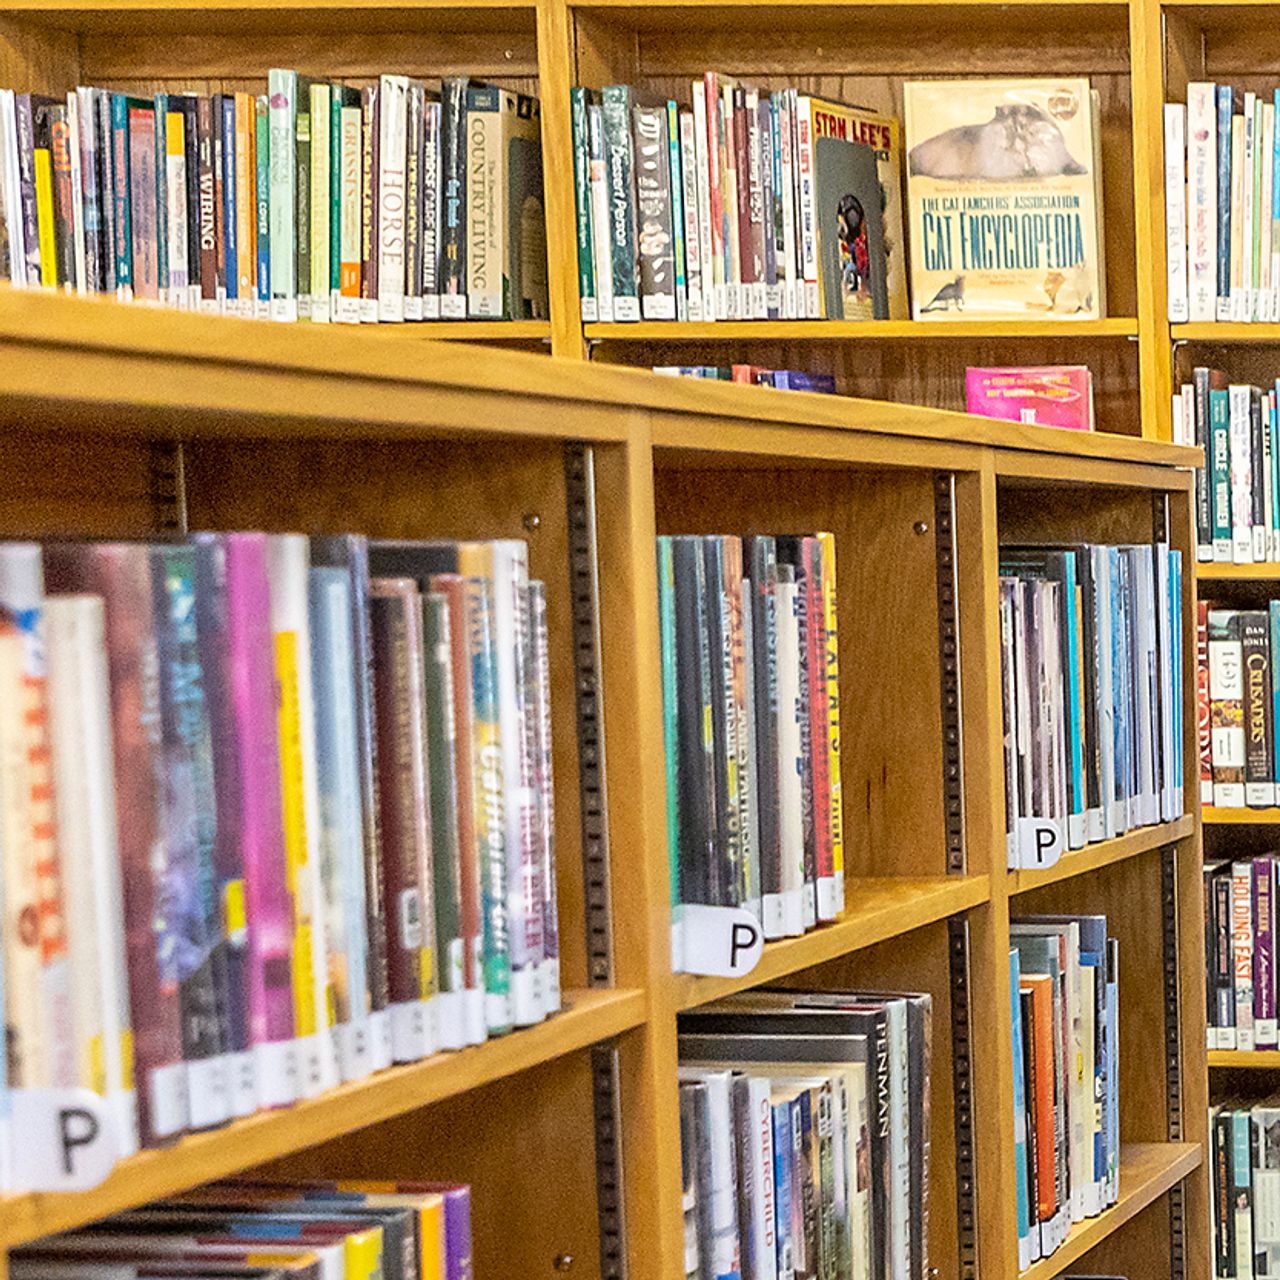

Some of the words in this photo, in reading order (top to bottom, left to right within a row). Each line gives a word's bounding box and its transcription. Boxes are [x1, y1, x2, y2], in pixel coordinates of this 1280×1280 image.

[815, 111, 847, 140] STAN
[852, 123, 891, 151] LEE'S
[471, 118, 486, 214] COUNTRY
[611, 144, 626, 198] Dessert
[200, 172, 215, 251] WIRING
[382, 168, 404, 267] HORSE
[613, 199, 628, 247] Person
[1014, 196, 1080, 211] ASSOCIATION
[471, 219, 486, 289] LIVING
[922, 211, 954, 271] CAT
[960, 210, 1086, 271] ENCYCLOPEDIA
[1245, 626, 1264, 635] DAN
[1246, 653, 1268, 743] CRUSADERS
[1035, 828, 1057, 862] P
[1233, 875, 1250, 940] HOLDING
[730, 923, 758, 968] P
[1236, 945, 1252, 979] FAST
[875, 1022, 889, 1138] PENMAN
[60, 1108, 101, 1175] P
[759, 1098, 774, 1248] CYBERCHILD
